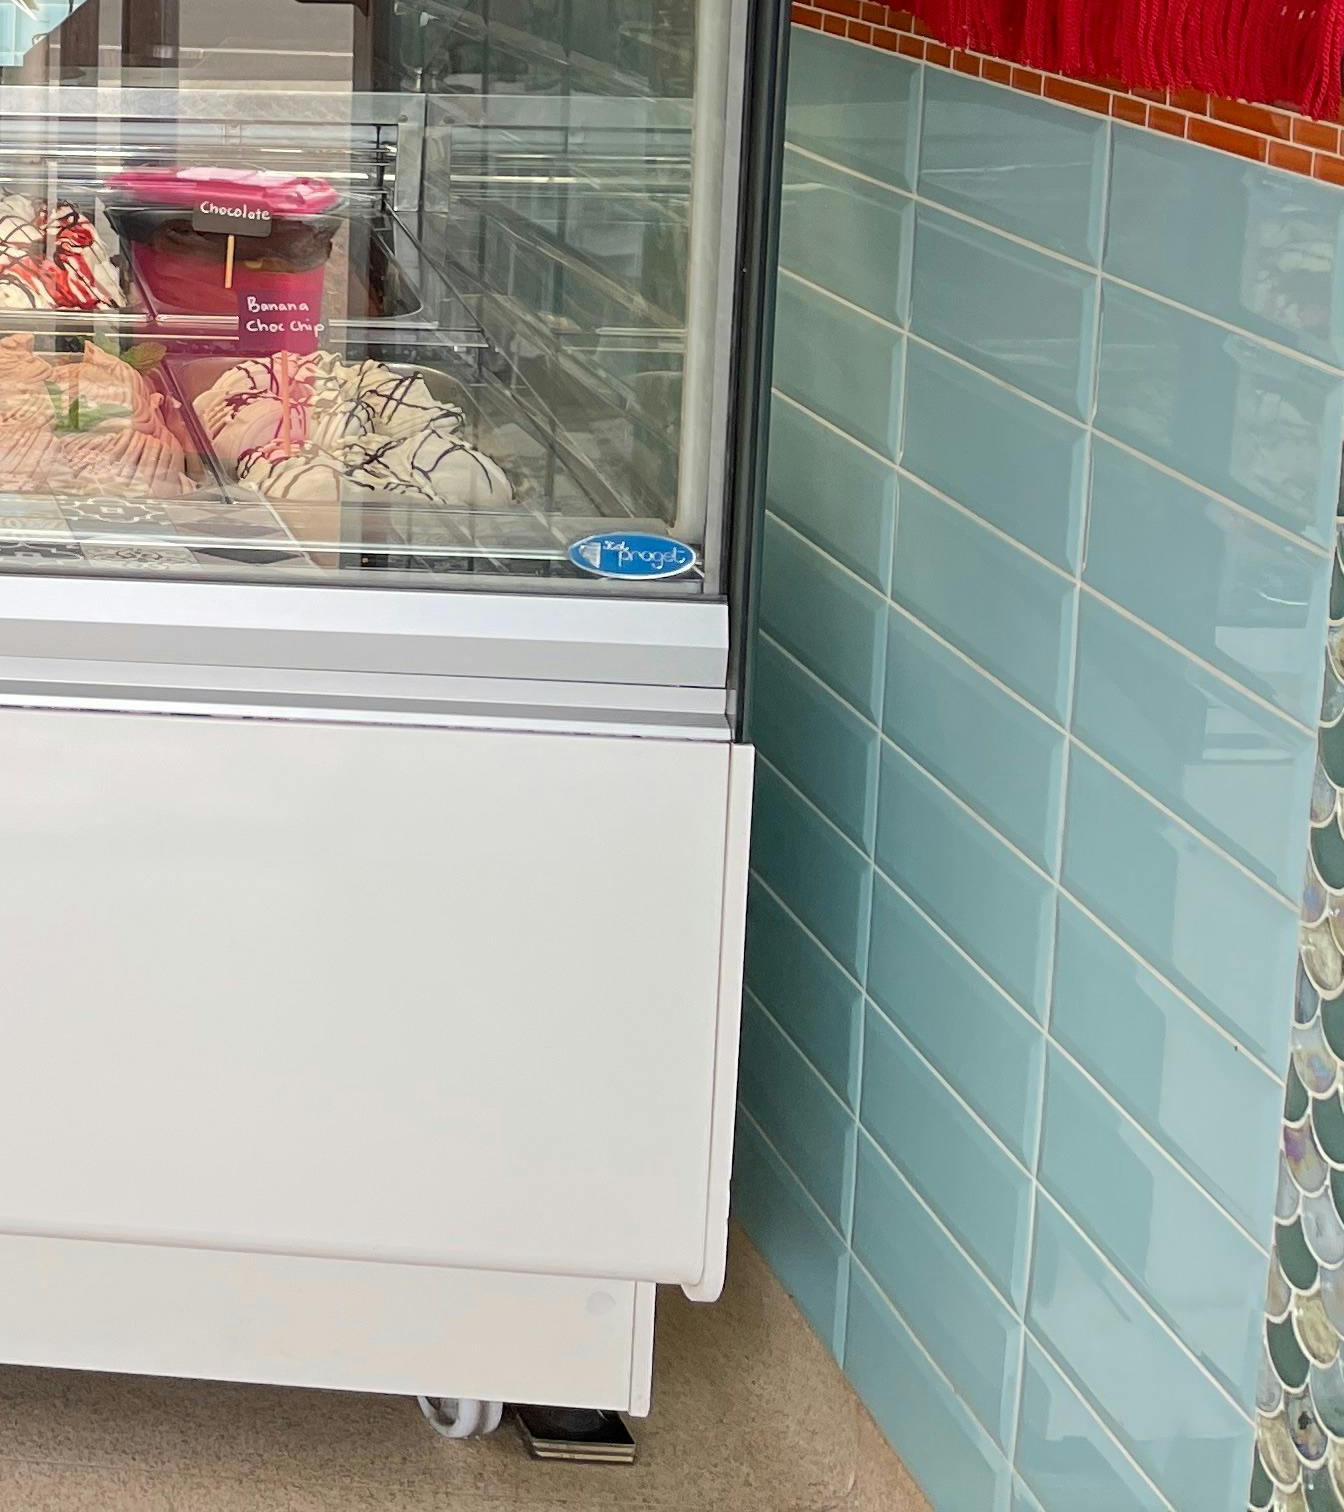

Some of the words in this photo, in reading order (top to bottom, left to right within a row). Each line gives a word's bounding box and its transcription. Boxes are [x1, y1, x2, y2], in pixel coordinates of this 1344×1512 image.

[200, 201, 271, 221] Chocolate
[247, 296, 310, 313] Banana
[246, 318, 284, 332] Choc
[289, 319, 325, 337] Chip
[619, 547, 686, 570] proget
